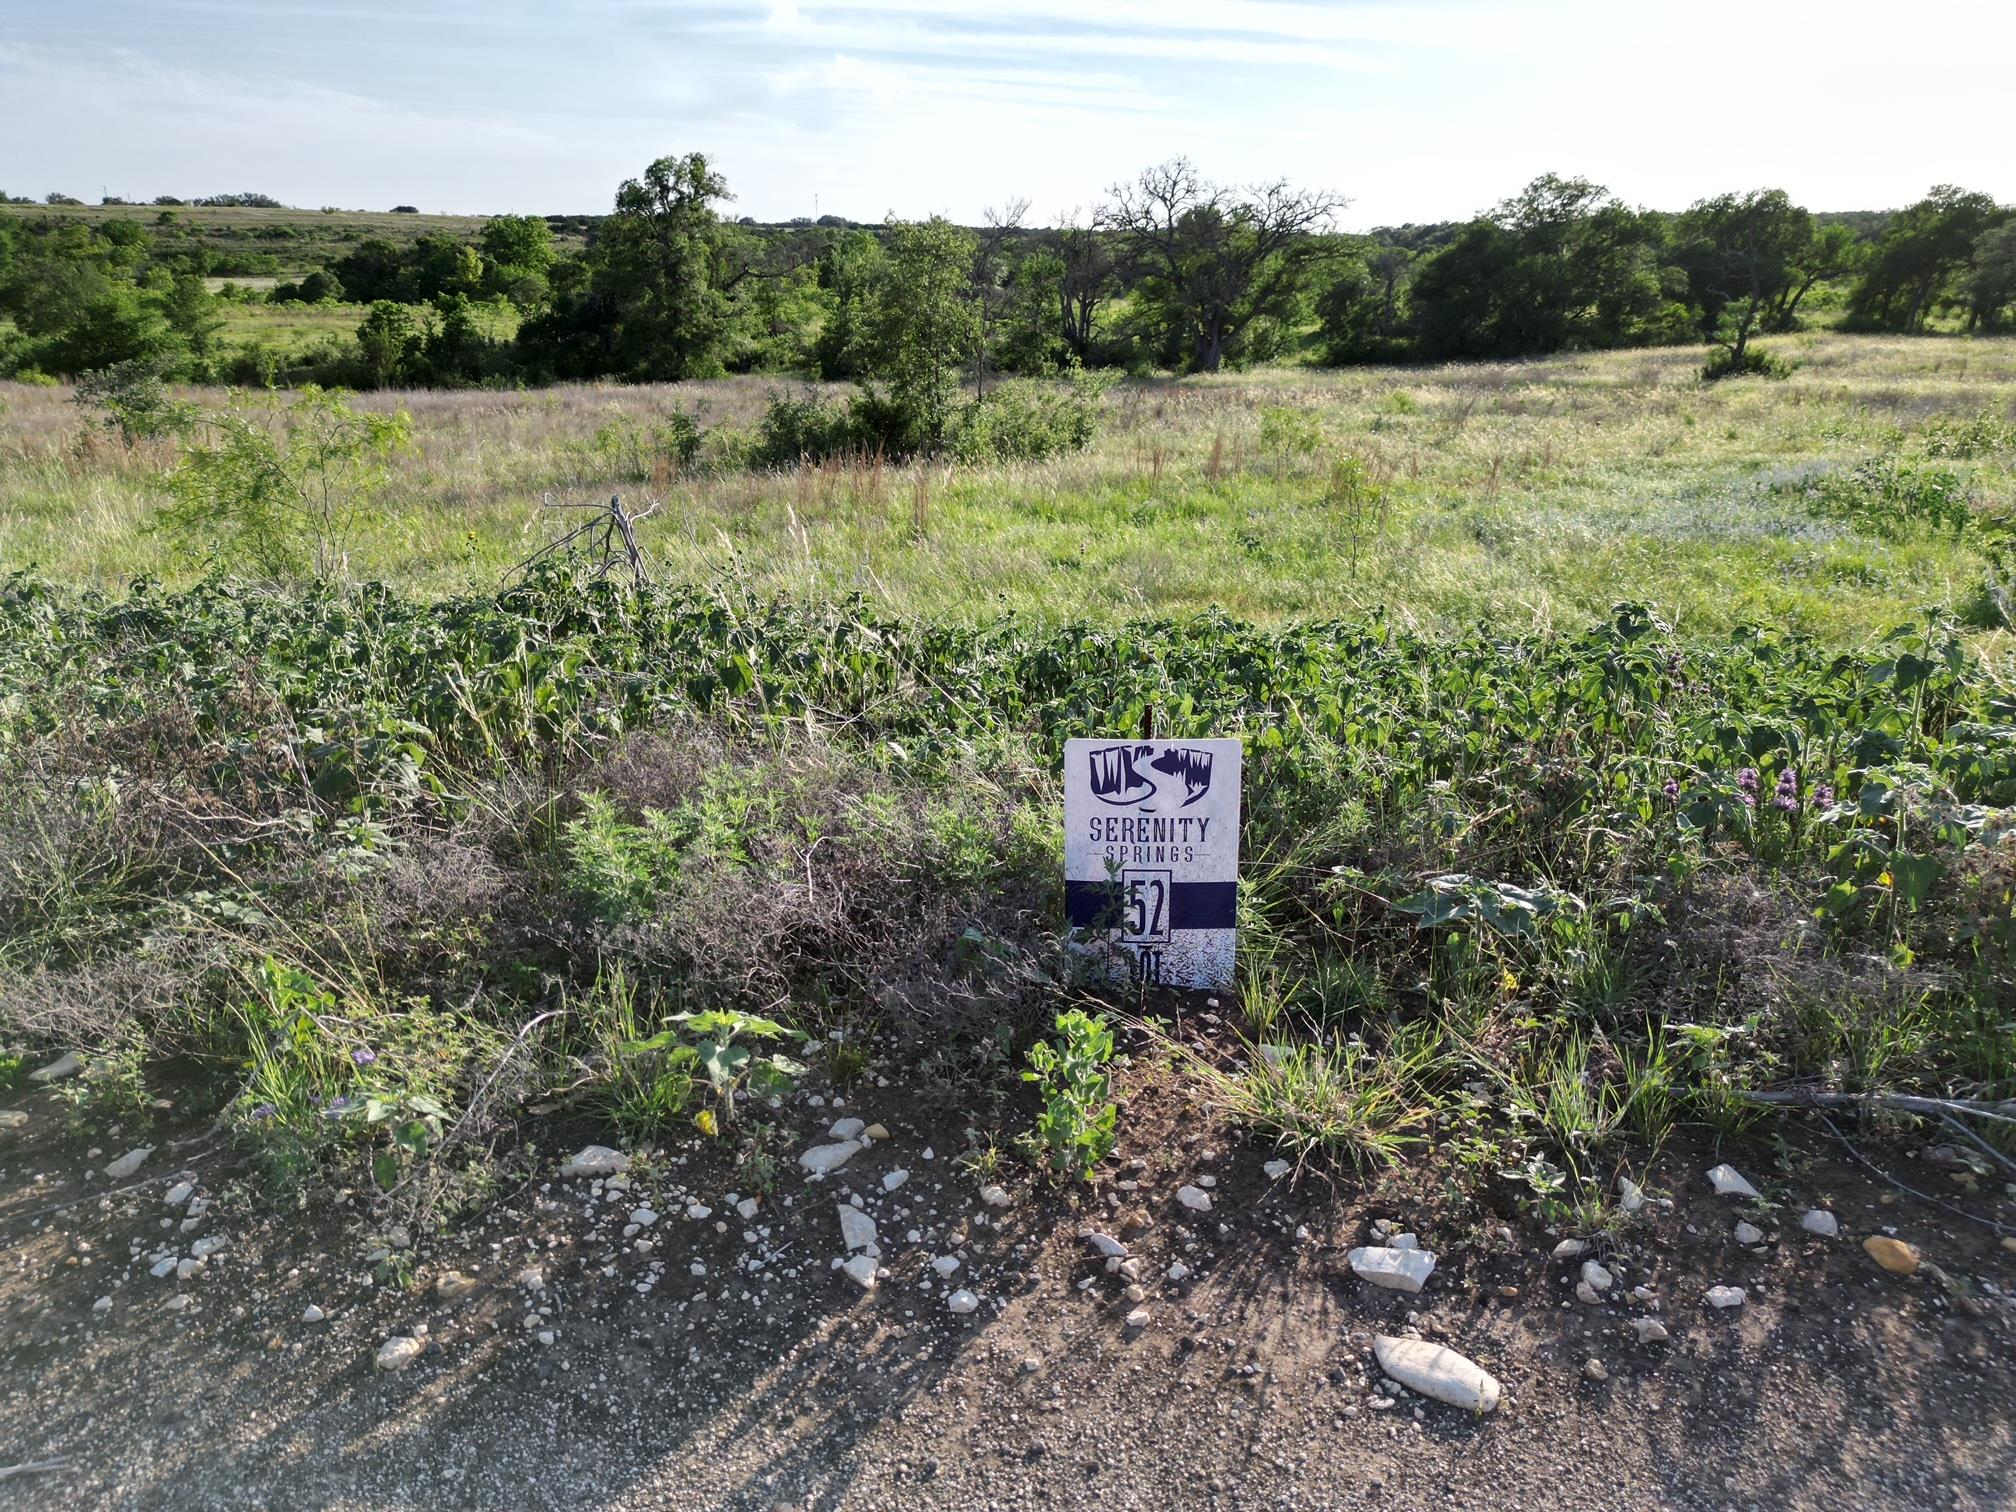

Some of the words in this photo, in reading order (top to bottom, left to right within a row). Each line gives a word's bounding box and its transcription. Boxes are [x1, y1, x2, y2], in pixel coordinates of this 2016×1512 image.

[1089, 817, 1211, 844] SERENITY
[1105, 845, 1194, 863] SPRINGS
[1129, 879, 1165, 936] 52
